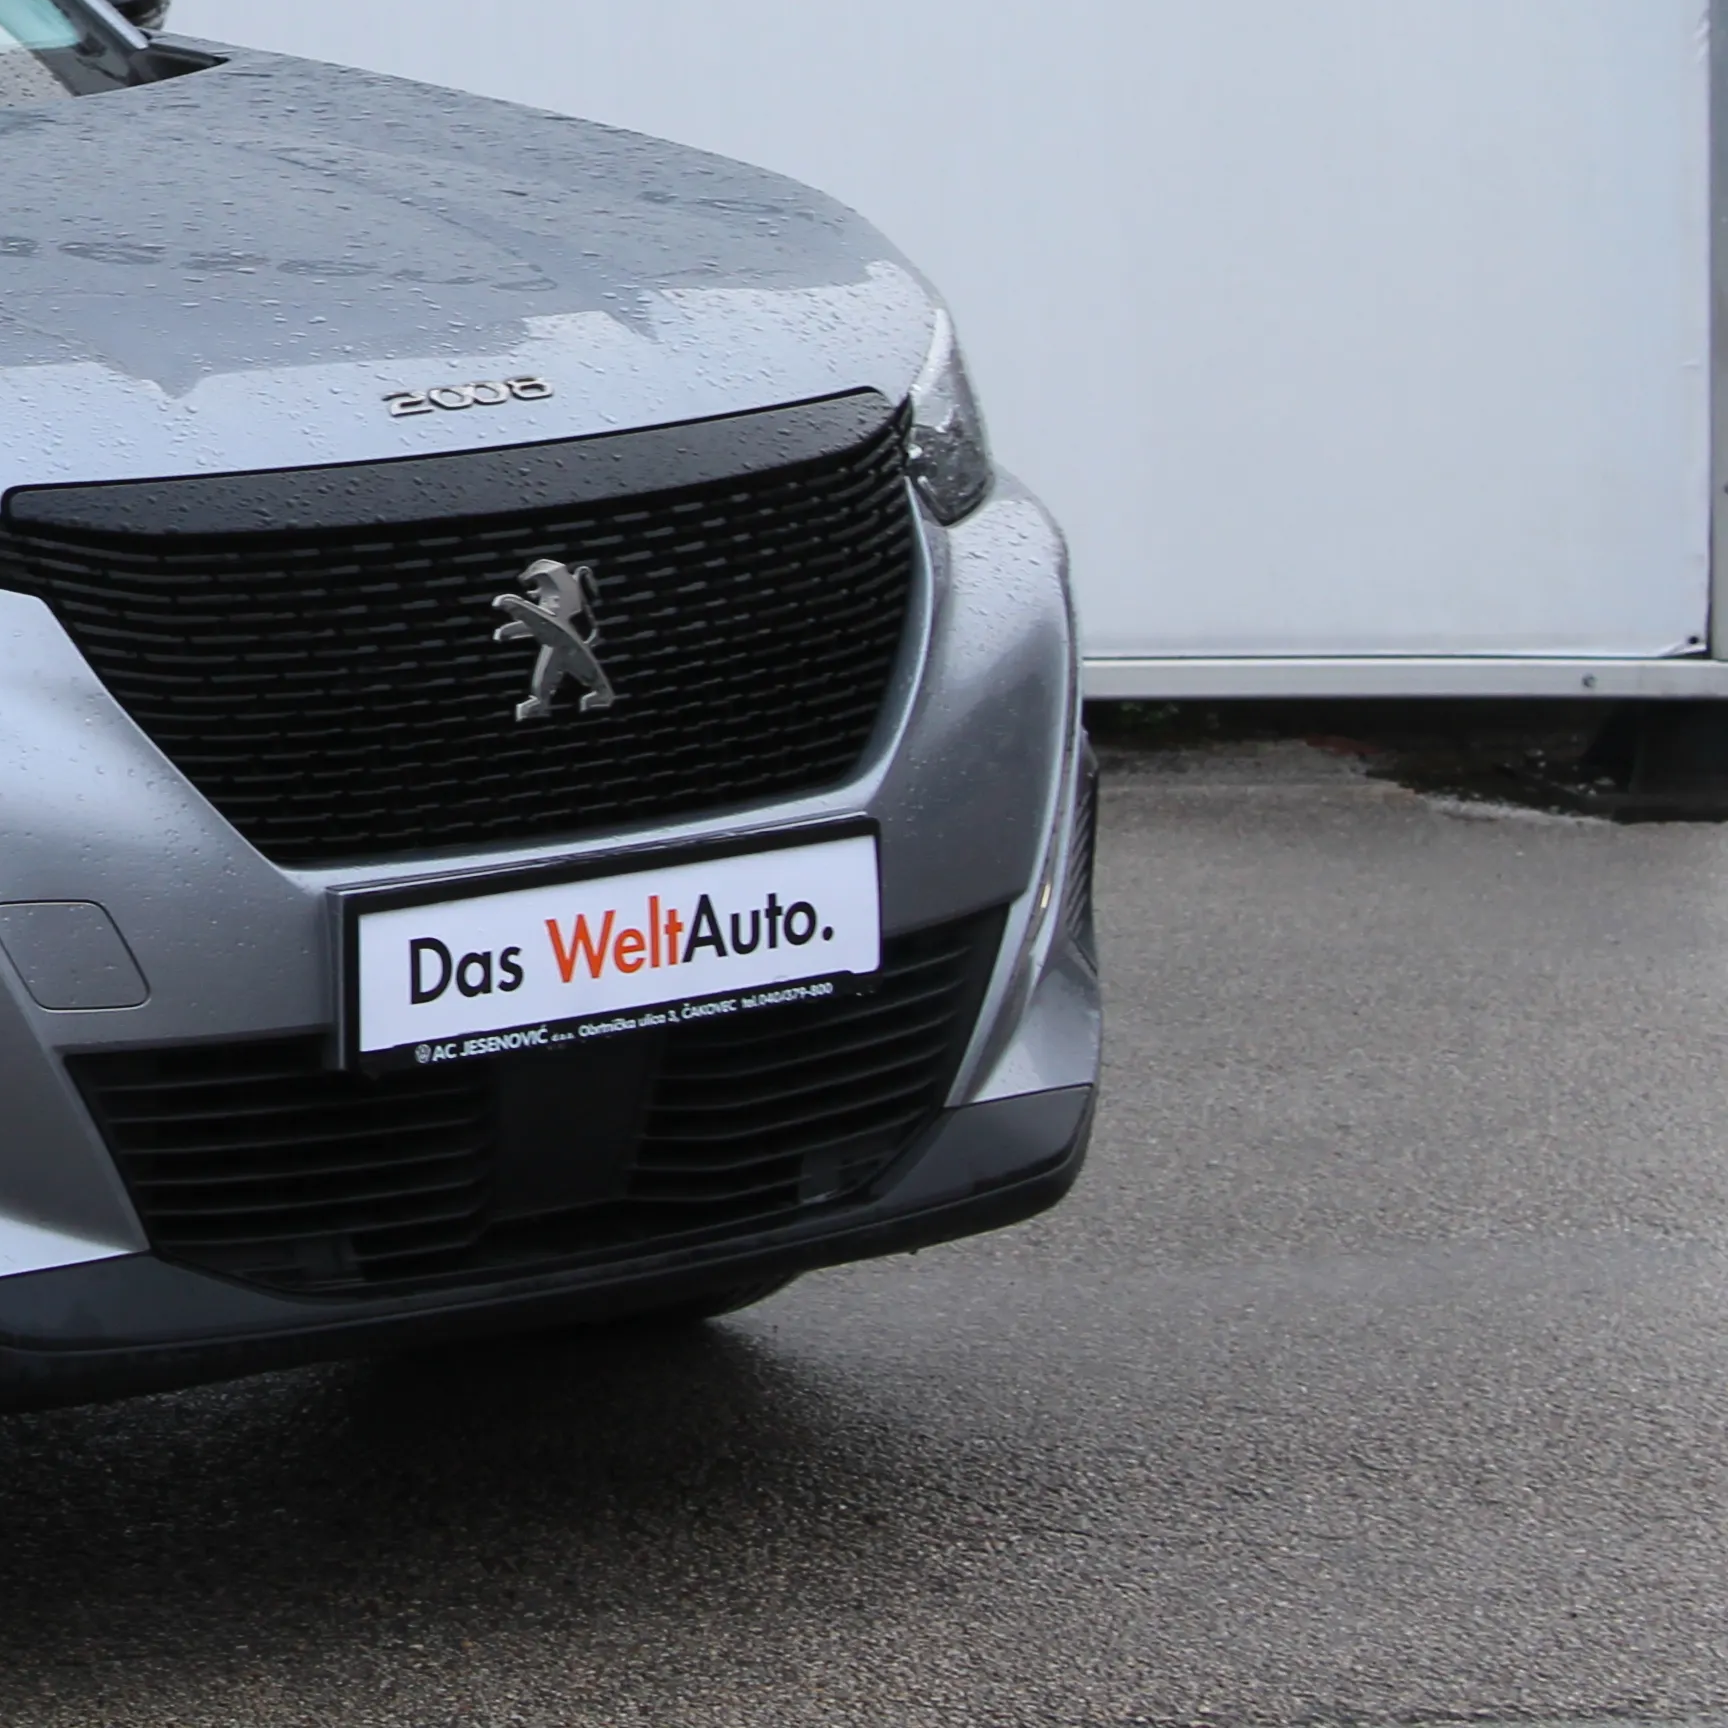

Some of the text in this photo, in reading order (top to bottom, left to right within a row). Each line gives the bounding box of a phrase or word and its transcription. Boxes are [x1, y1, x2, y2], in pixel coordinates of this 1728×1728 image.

[382, 376, 553, 418] 2008
[409, 892, 834, 1005] Das WeltAuto.
[431, 1043, 458, 1062] AC
[459, 1024, 549, 1057] JESENOVIĆ
[637, 1013, 666, 1027] ulica
[681, 1003, 737, 1019] ČAKOVEC
